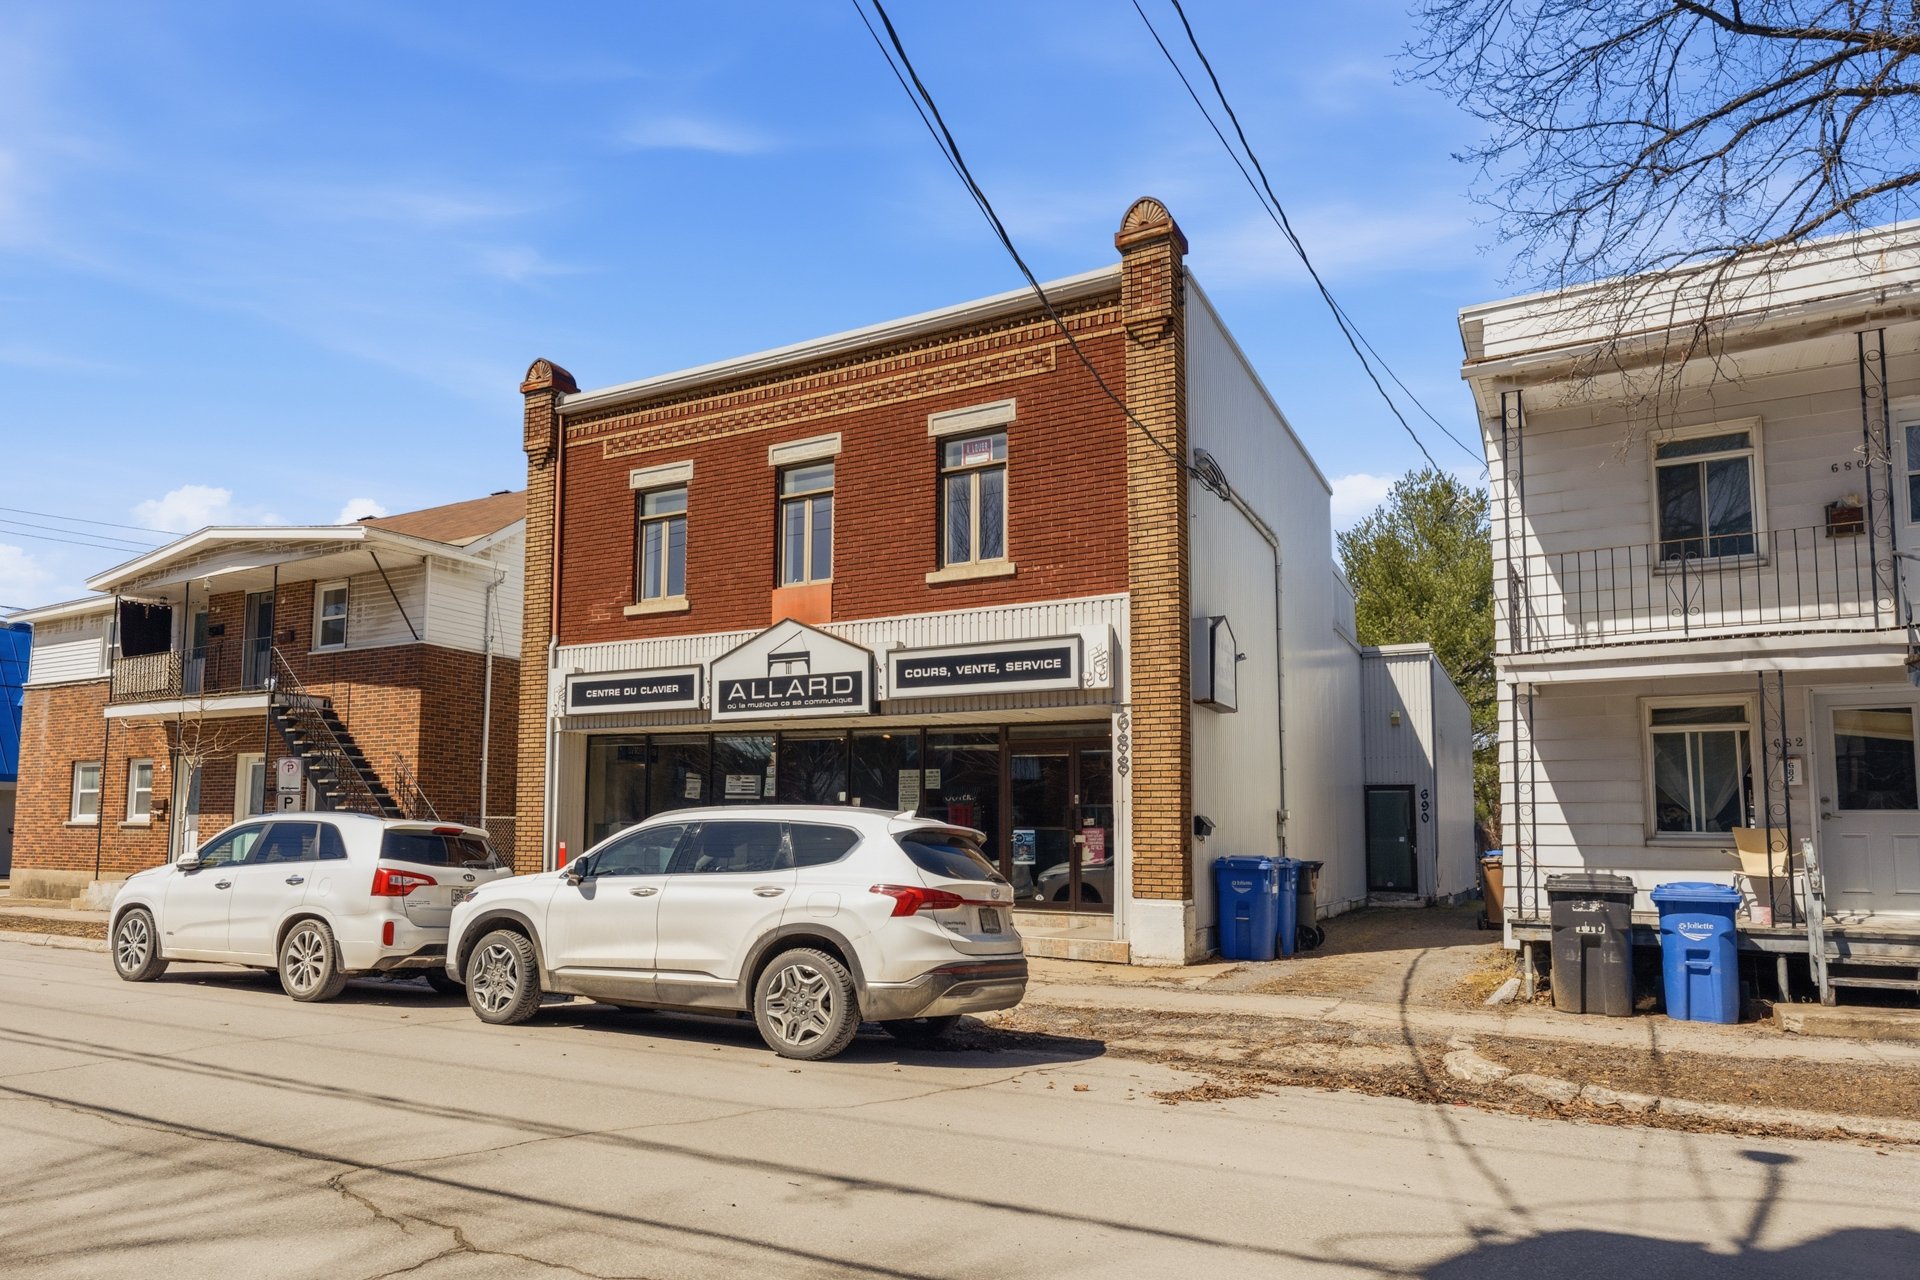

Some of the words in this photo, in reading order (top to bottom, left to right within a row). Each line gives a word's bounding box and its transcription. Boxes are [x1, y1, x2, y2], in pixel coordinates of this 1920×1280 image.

[1831, 459, 1864, 473] 680
[905, 666, 951, 678] COURS,
[956, 663, 1000, 675] VENTE,
[1005, 658, 1062, 672] SERVICE
[586, 688, 620, 698] CENTRE
[623, 687, 637, 696] DU
[640, 684, 679, 695] CLAVIER
[728, 675, 853, 701] ALLARD
[747, 700, 779, 709] musique
[804, 696, 853, 706] communique
[1117, 711, 1129, 777] 688
[1773, 736, 1804, 749] 682
[284, 797, 294, 809] P
[1420, 789, 1430, 823] 690
